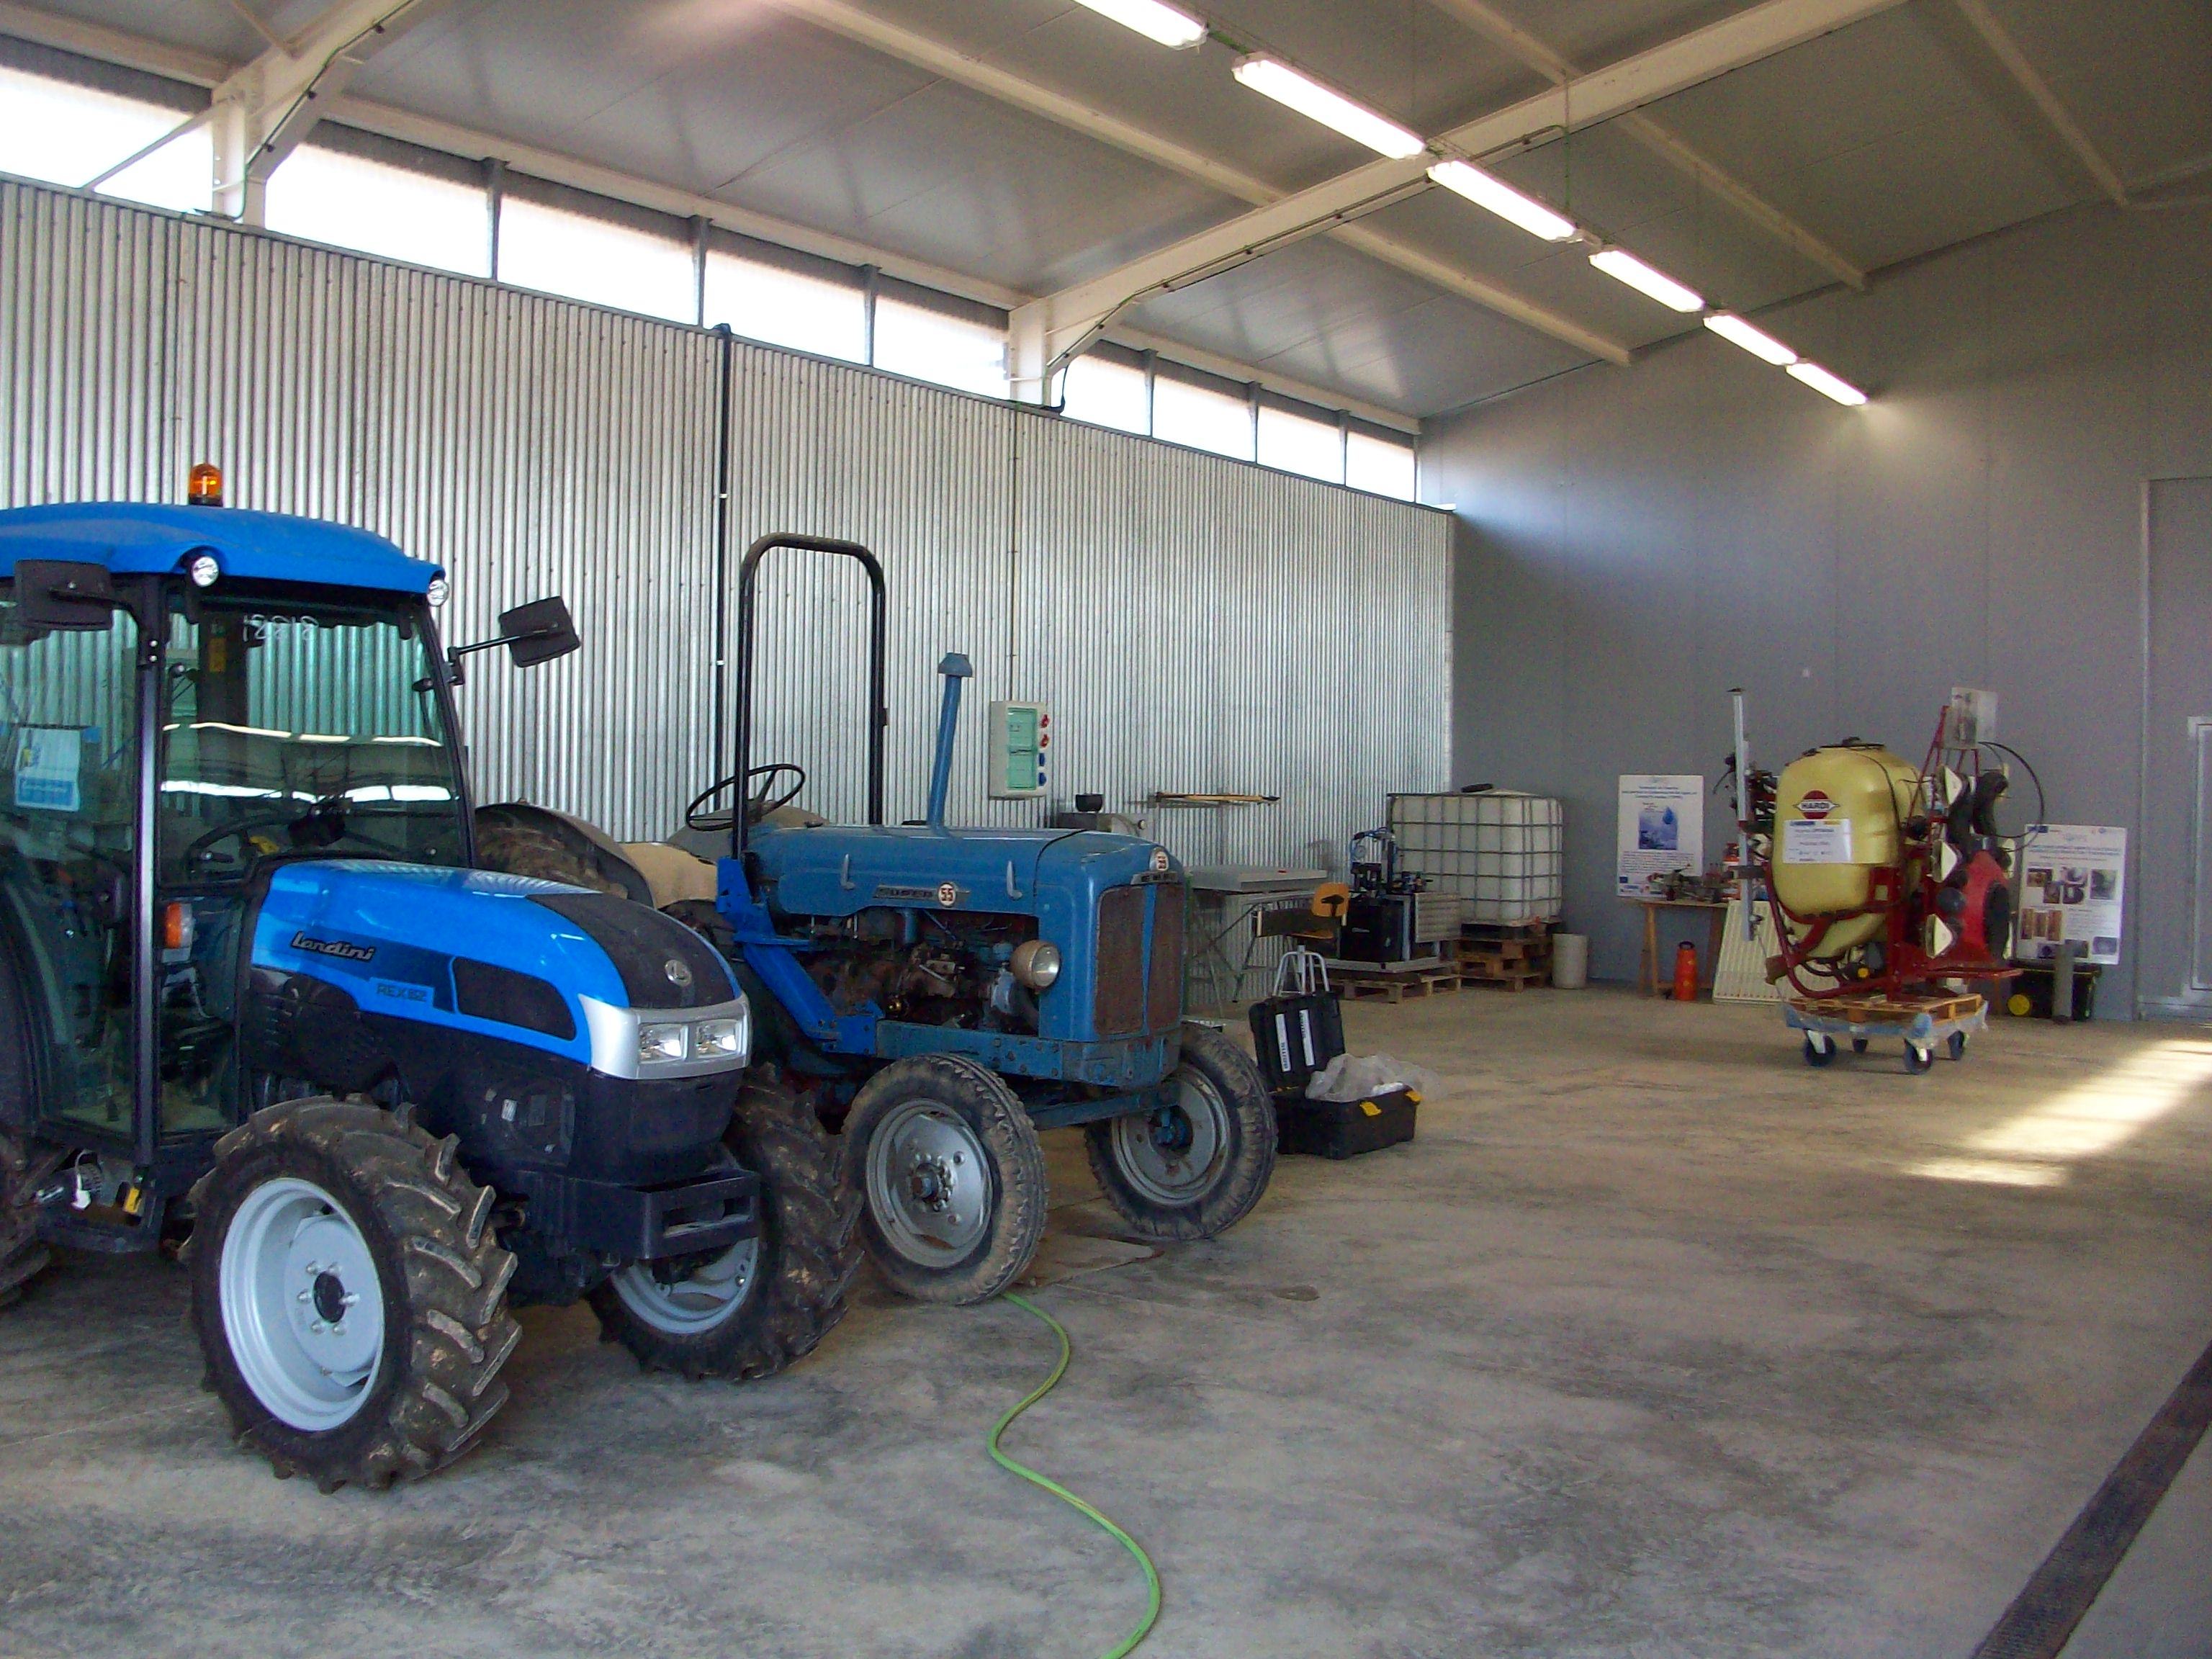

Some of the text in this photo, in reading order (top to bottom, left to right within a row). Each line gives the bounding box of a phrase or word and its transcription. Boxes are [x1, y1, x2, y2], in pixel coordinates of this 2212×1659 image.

[940, 887, 954, 902] 55
[291, 930, 375, 962] Landini
[377, 983, 408, 999] REX
